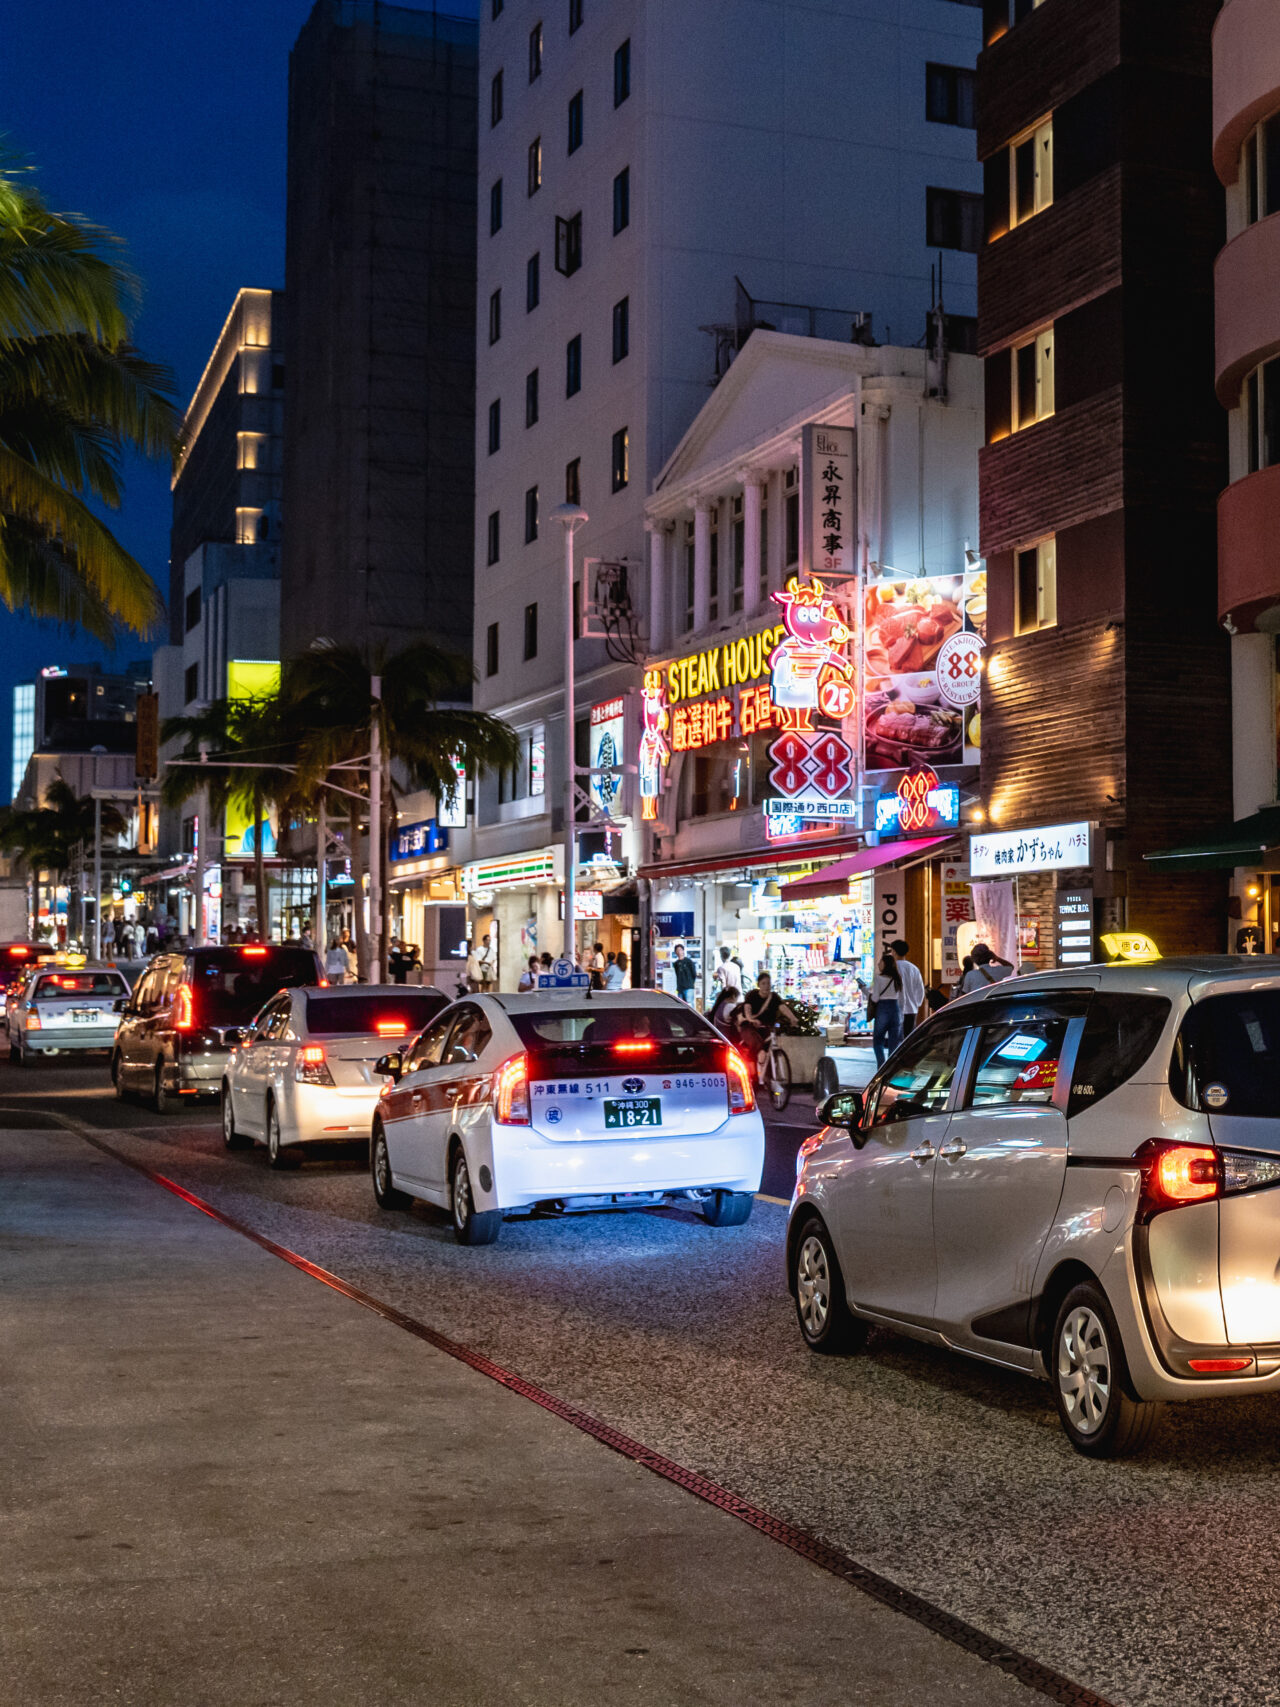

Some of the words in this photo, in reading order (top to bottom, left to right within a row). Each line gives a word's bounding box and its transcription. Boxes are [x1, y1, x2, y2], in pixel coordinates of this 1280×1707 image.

[822, 460, 844, 556] 永昇商事
[824, 557, 843, 569] 3F
[668, 647, 720, 704] STEAK
[825, 684, 850, 714] 2F
[671, 695, 735, 753] 厳選和牛
[771, 801, 851, 815] 国際通り西口店
[1016, 836, 1064, 863] かずちゃん
[1068, 833, 1088, 848] ハラミ
[945, 897, 971, 922] 薬
[534, 1083, 580, 1096] 沖東無線
[585, 1081, 610, 1094] 511
[675, 1077, 726, 1089] 946-5005
[619, 1108, 658, 1126] 18-21
